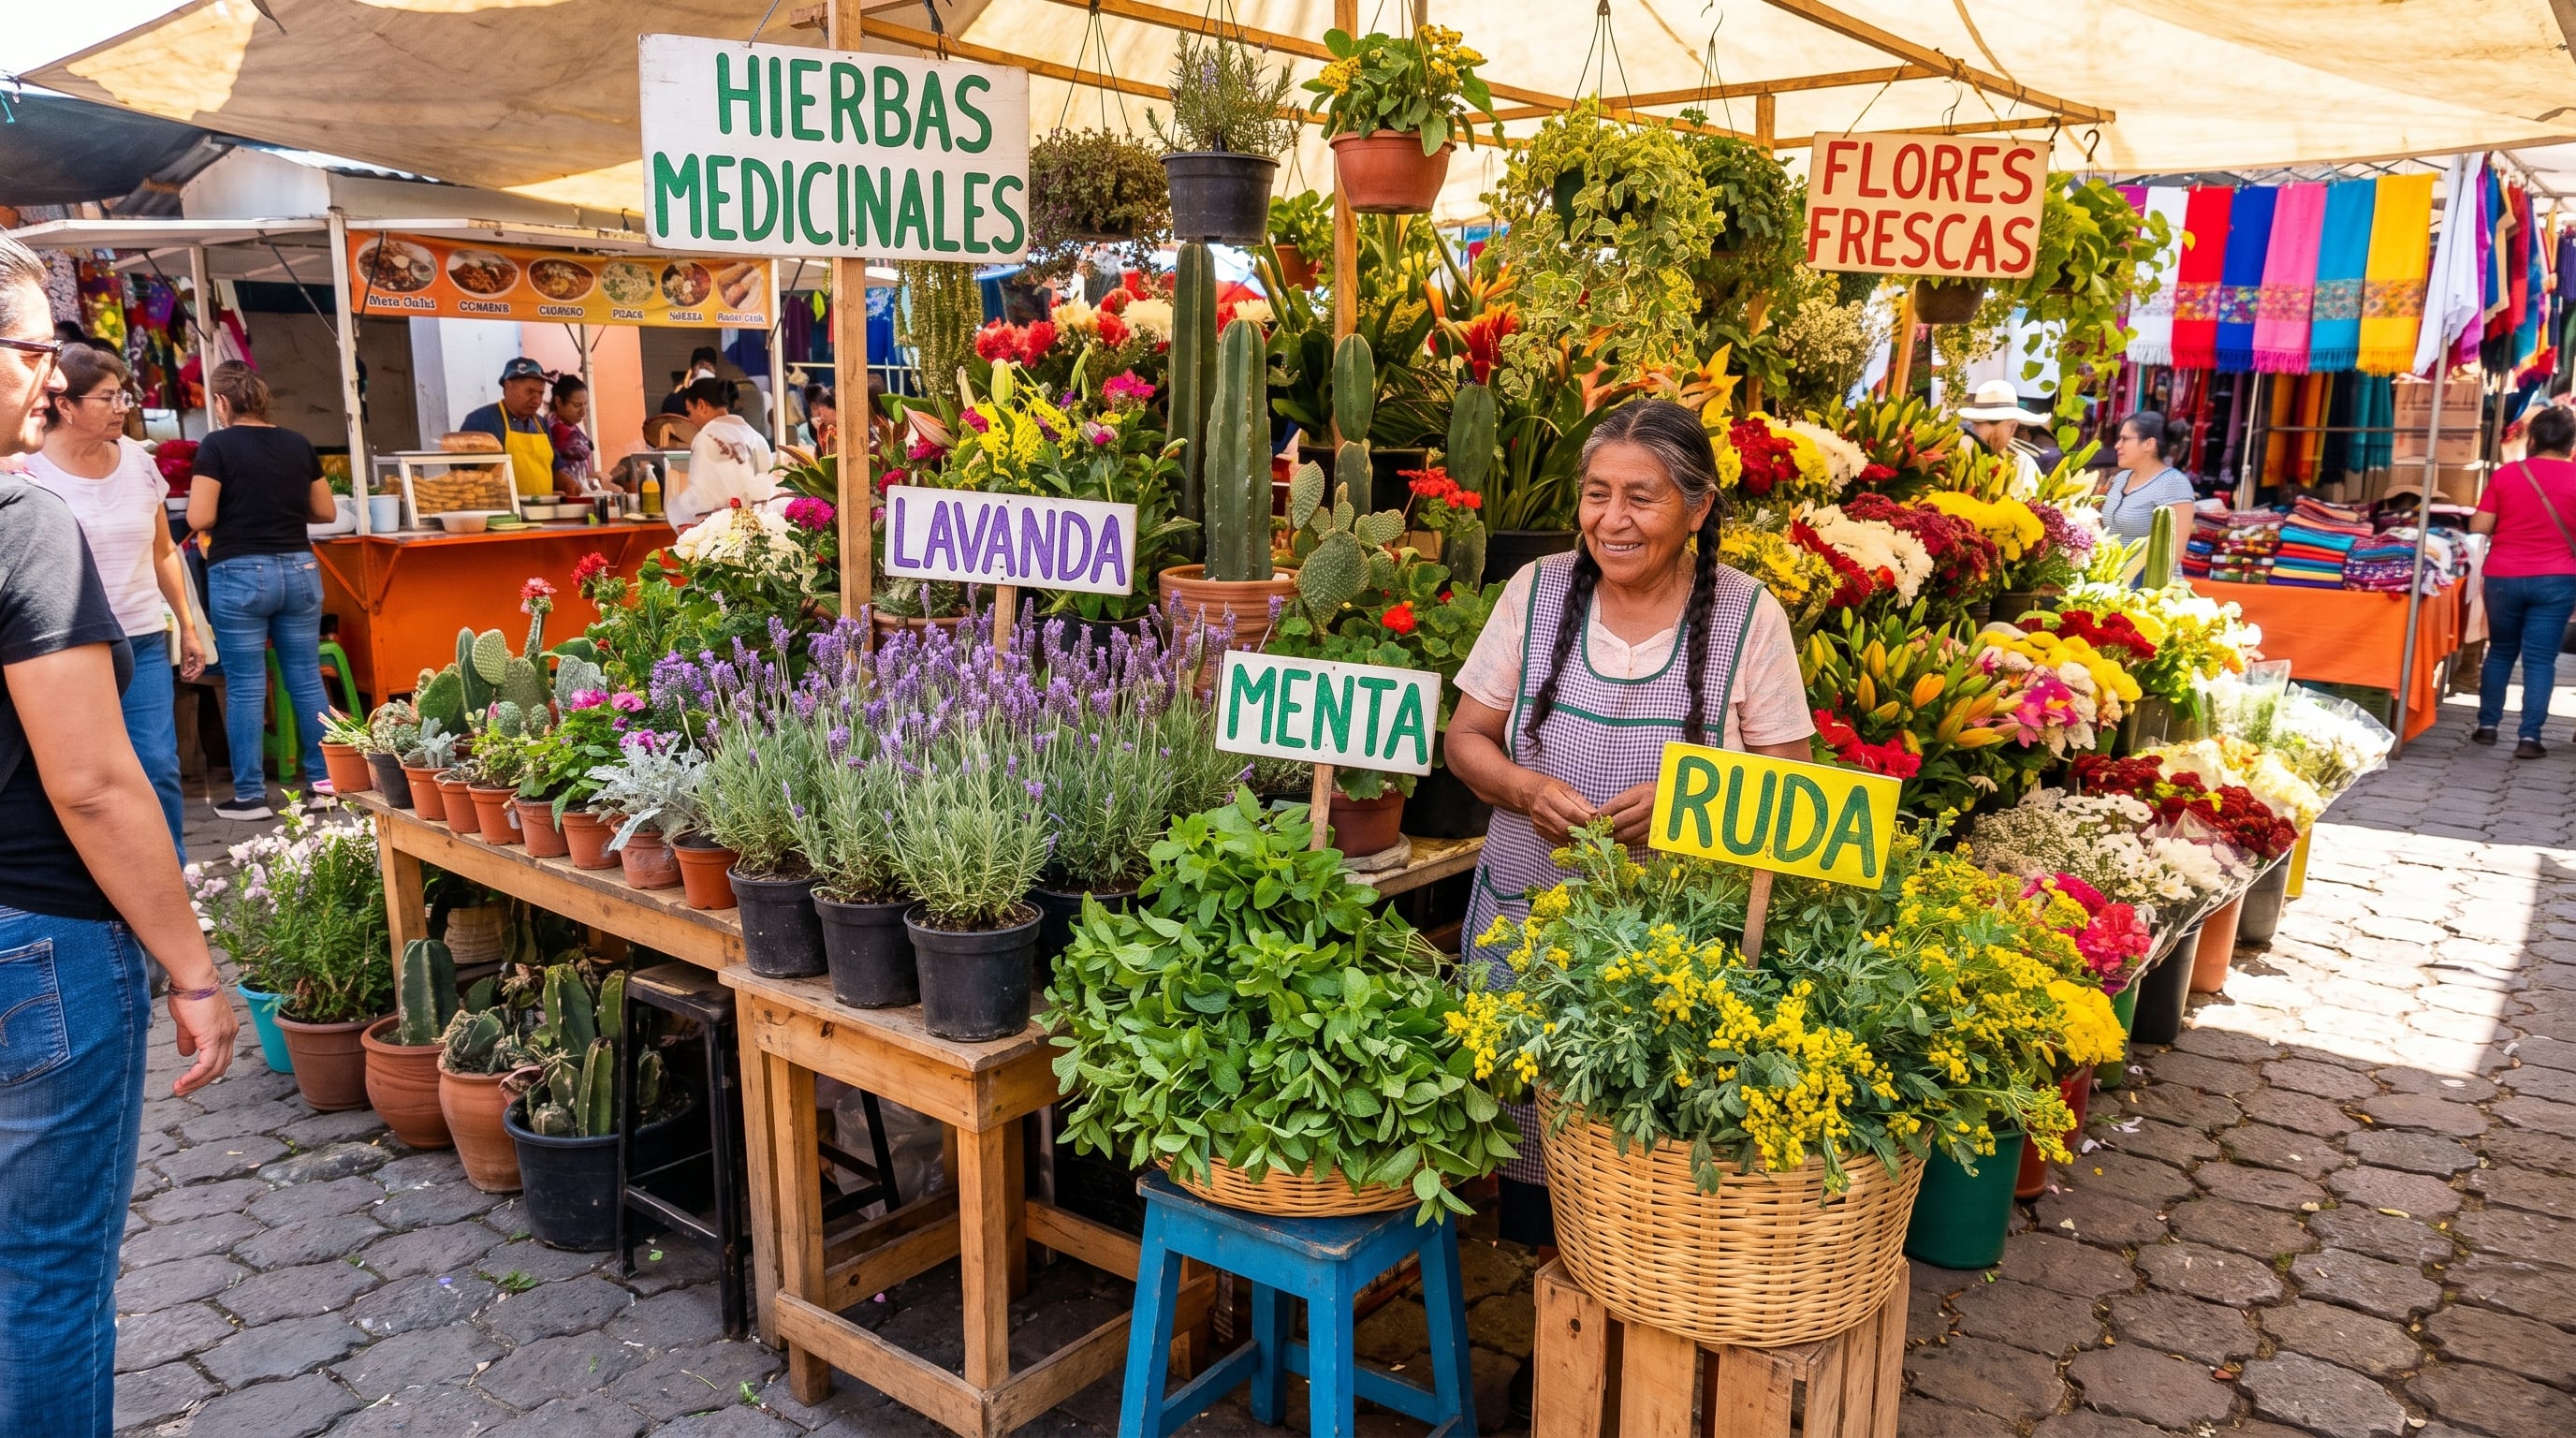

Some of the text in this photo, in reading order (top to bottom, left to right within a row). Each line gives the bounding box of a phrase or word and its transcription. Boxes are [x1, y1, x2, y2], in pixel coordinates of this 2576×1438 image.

[715, 51, 993, 155] HIERBAS
[652, 150, 1026, 255] MEDICINALES
[1822, 139, 2037, 205] FLORES
[1808, 206, 2035, 274] FRESCAS
[892, 495, 1127, 588] LAVANDA
[1226, 662, 1429, 766] MENTA
[1667, 756, 1878, 878] RUDA
